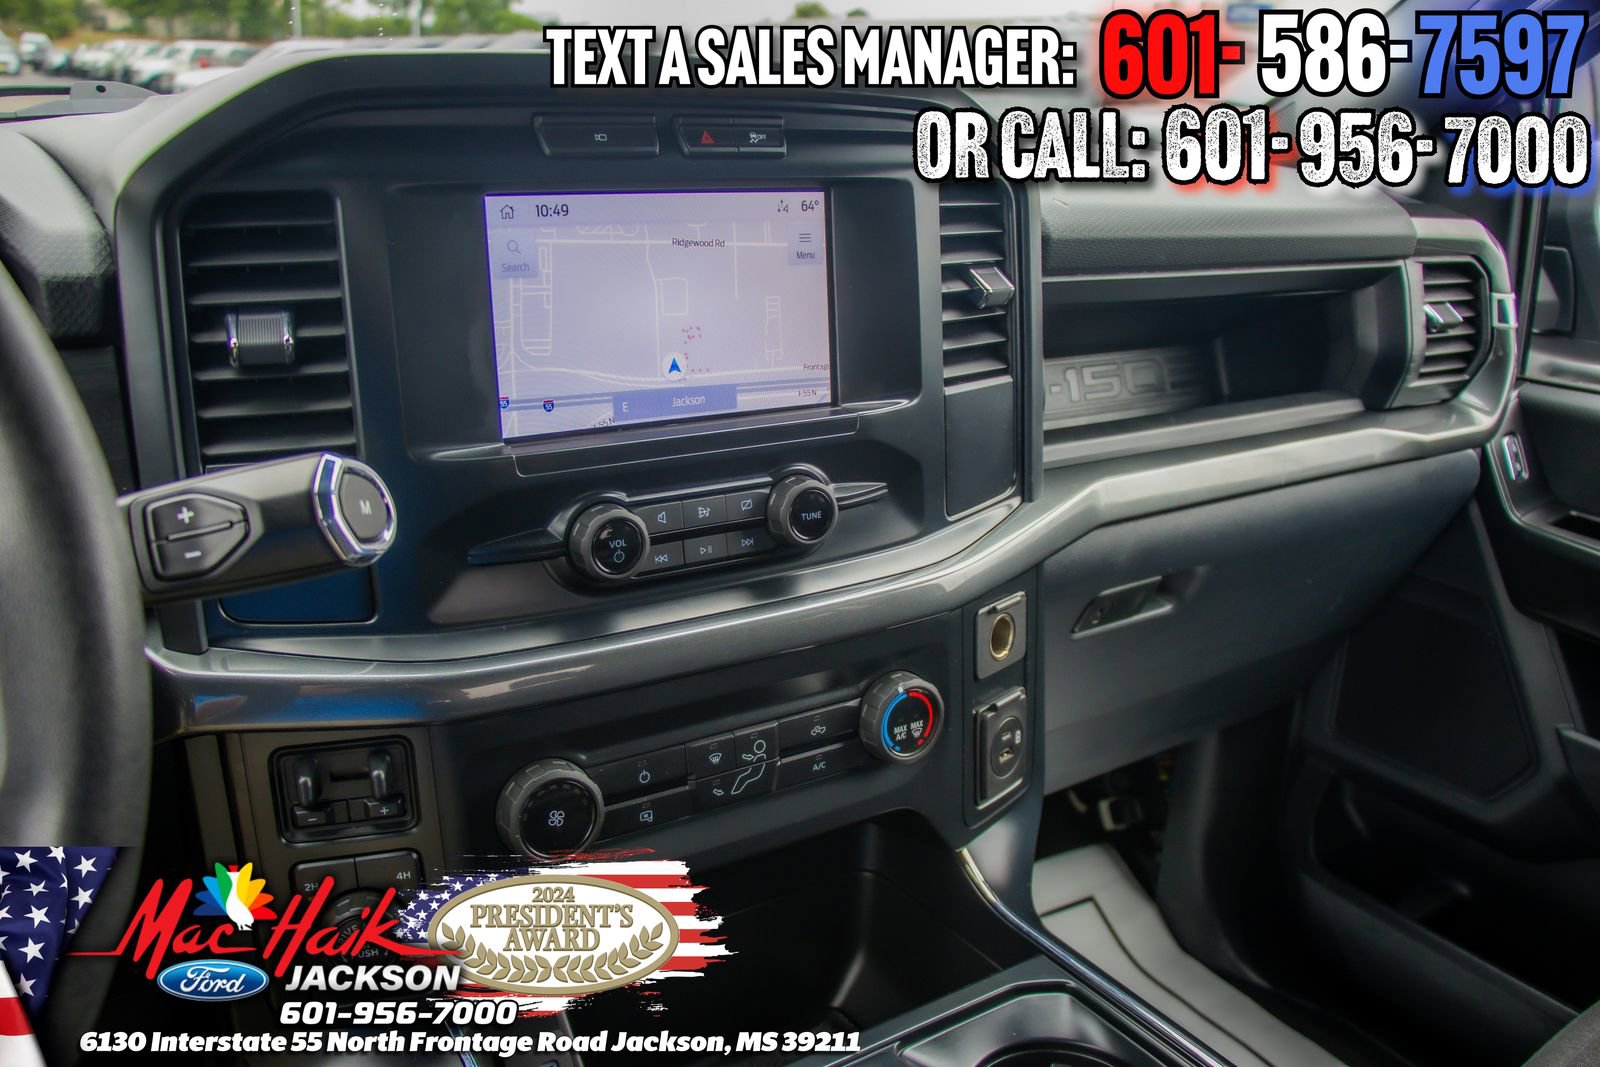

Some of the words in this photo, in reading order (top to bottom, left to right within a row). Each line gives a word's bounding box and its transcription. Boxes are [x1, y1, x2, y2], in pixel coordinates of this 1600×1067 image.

[535, 204, 569, 218] 10:49
[800, 199, 820, 212] 64°
[671, 238, 713, 248] Ridgewood
[714, 238, 726, 249] Rd
[796, 250, 816, 261] Menu
[501, 262, 530, 274] Search
[672, 394, 706, 407] Jackson
[622, 401, 629, 412] E
[360, 500, 372, 515] M
[801, 511, 823, 521] TUNE
[609, 540, 627, 549] VOL
[894, 725, 907, 734] MAX
[911, 720, 923, 729] MAX
[895, 732, 907, 741] A/C
[812, 760, 827, 771] A/C
[396, 871, 411, 880] 4H
